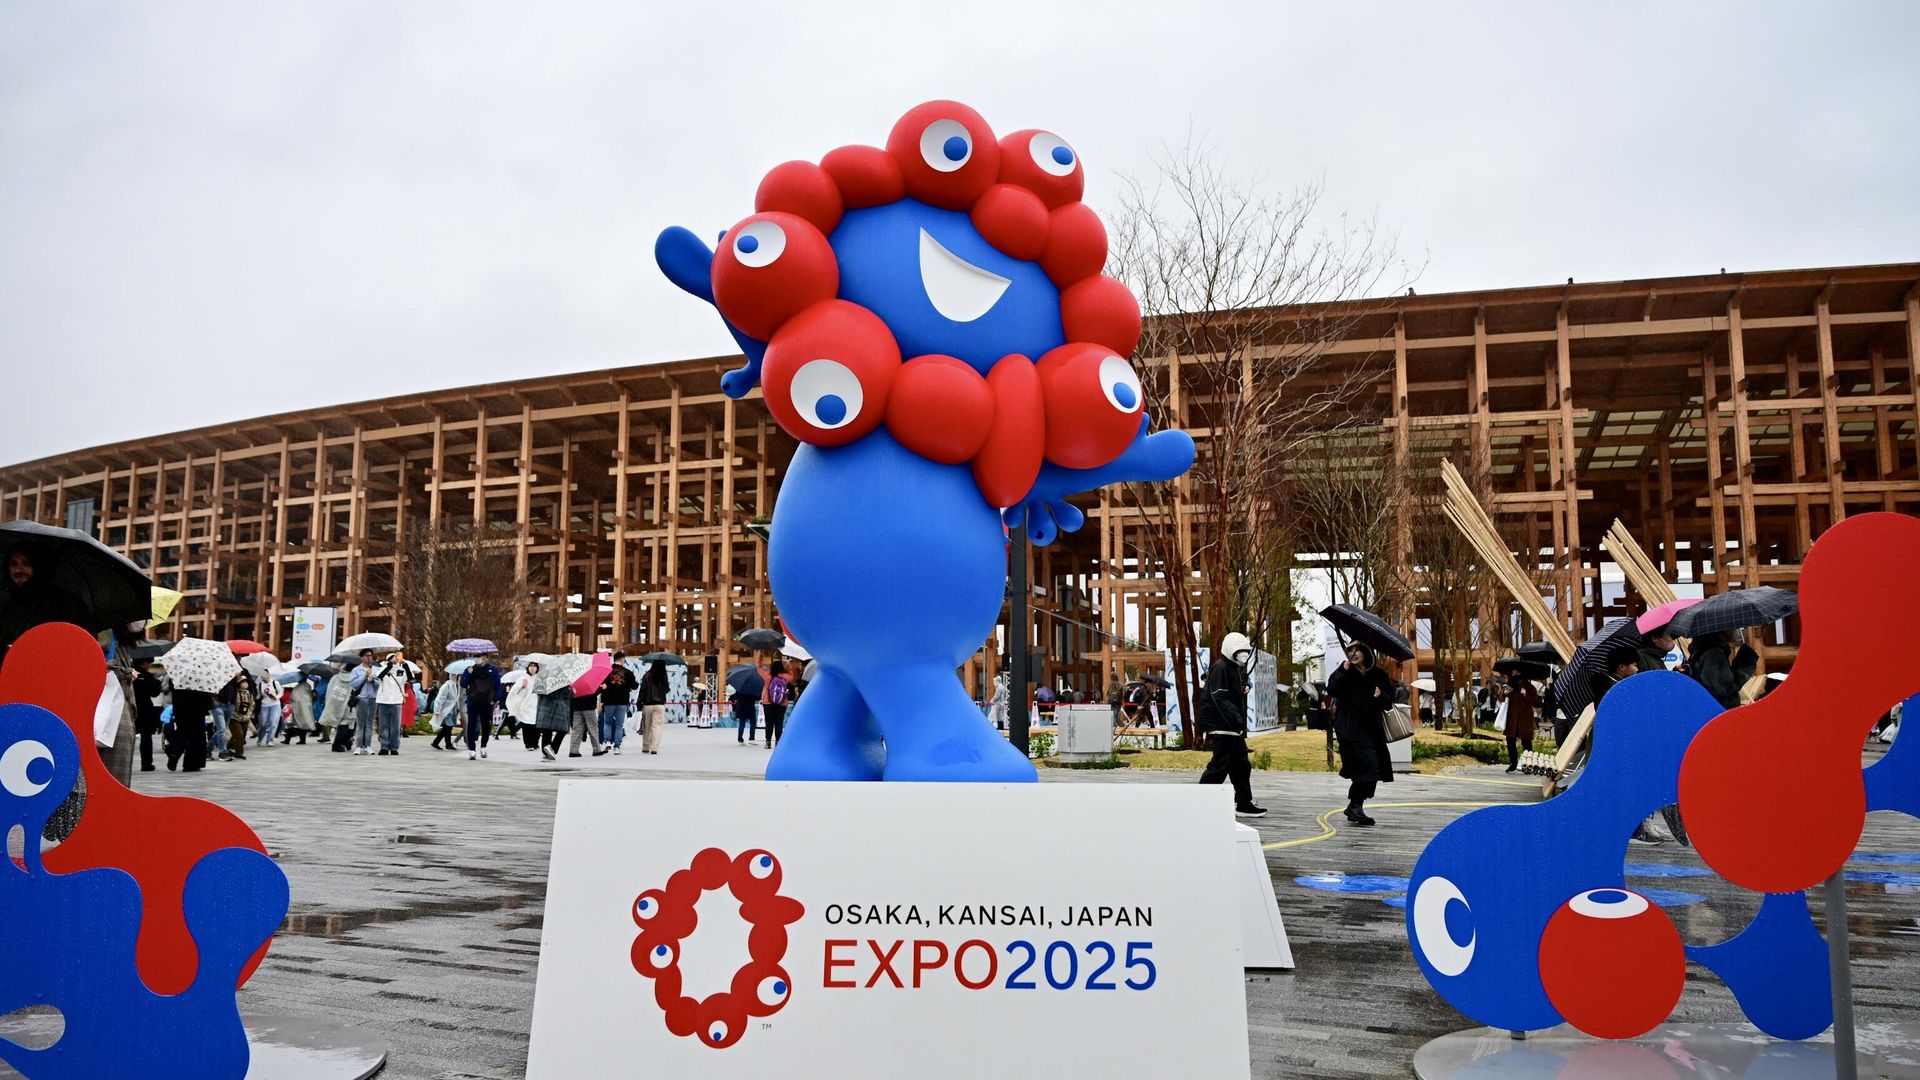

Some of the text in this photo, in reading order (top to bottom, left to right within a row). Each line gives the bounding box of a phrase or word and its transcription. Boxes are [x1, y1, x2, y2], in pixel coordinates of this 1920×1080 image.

[825, 903, 1153, 930] OSAKA, KANSAI, JAPAN
[822, 938, 1157, 992] EXPO2025
